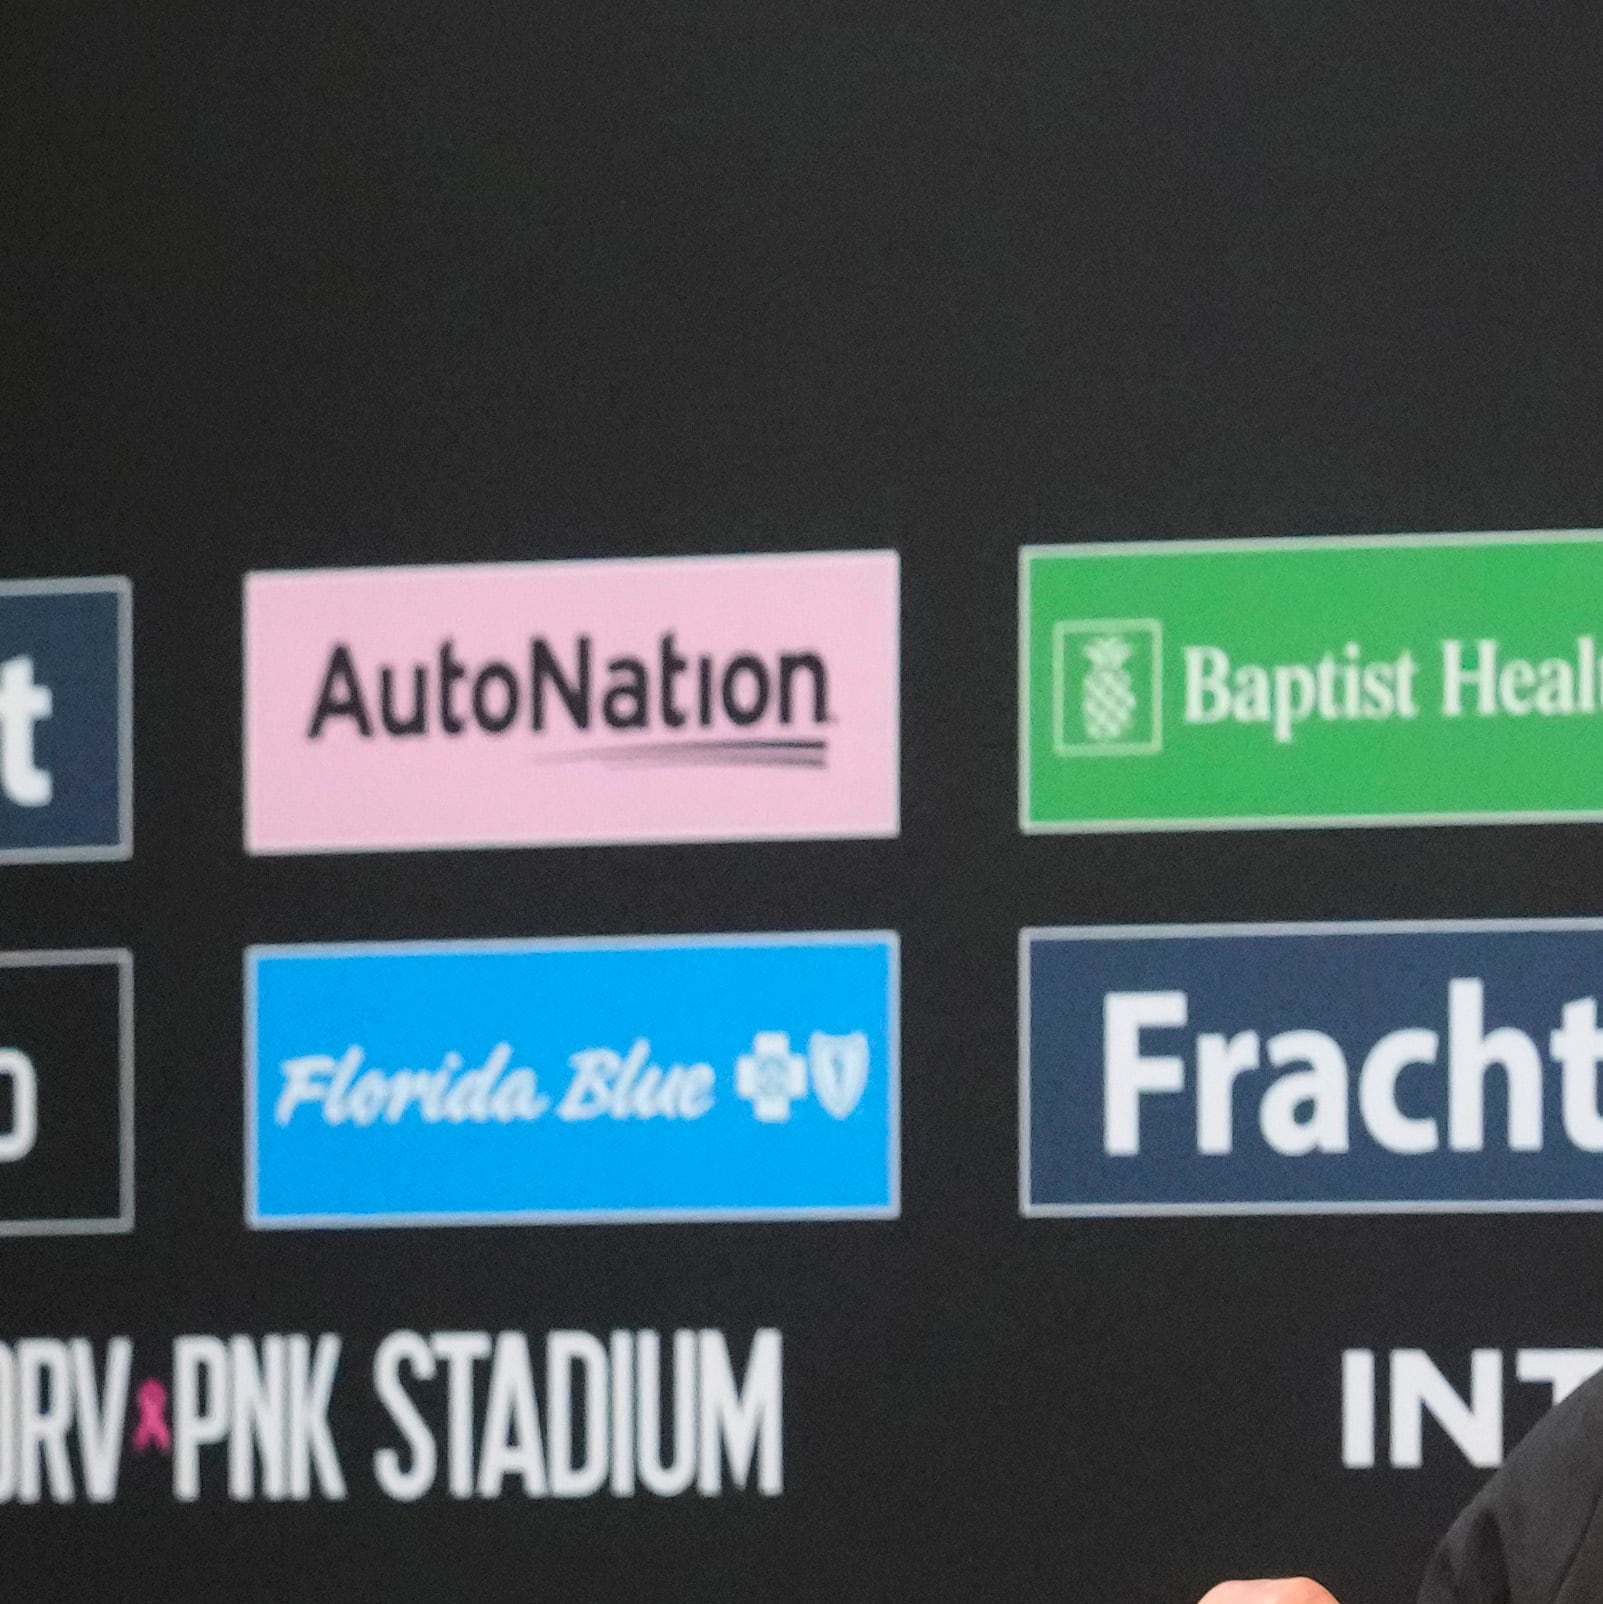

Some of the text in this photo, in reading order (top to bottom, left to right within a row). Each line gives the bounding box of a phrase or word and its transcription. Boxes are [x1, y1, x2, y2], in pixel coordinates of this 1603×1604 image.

[307, 631, 832, 742] AutoNation
[1183, 641, 1419, 744] Baptist
[274, 1037, 717, 1127] Florida Blue
[173, 1333, 346, 1502] PNK
[373, 1327, 784, 1501] STADIUM
